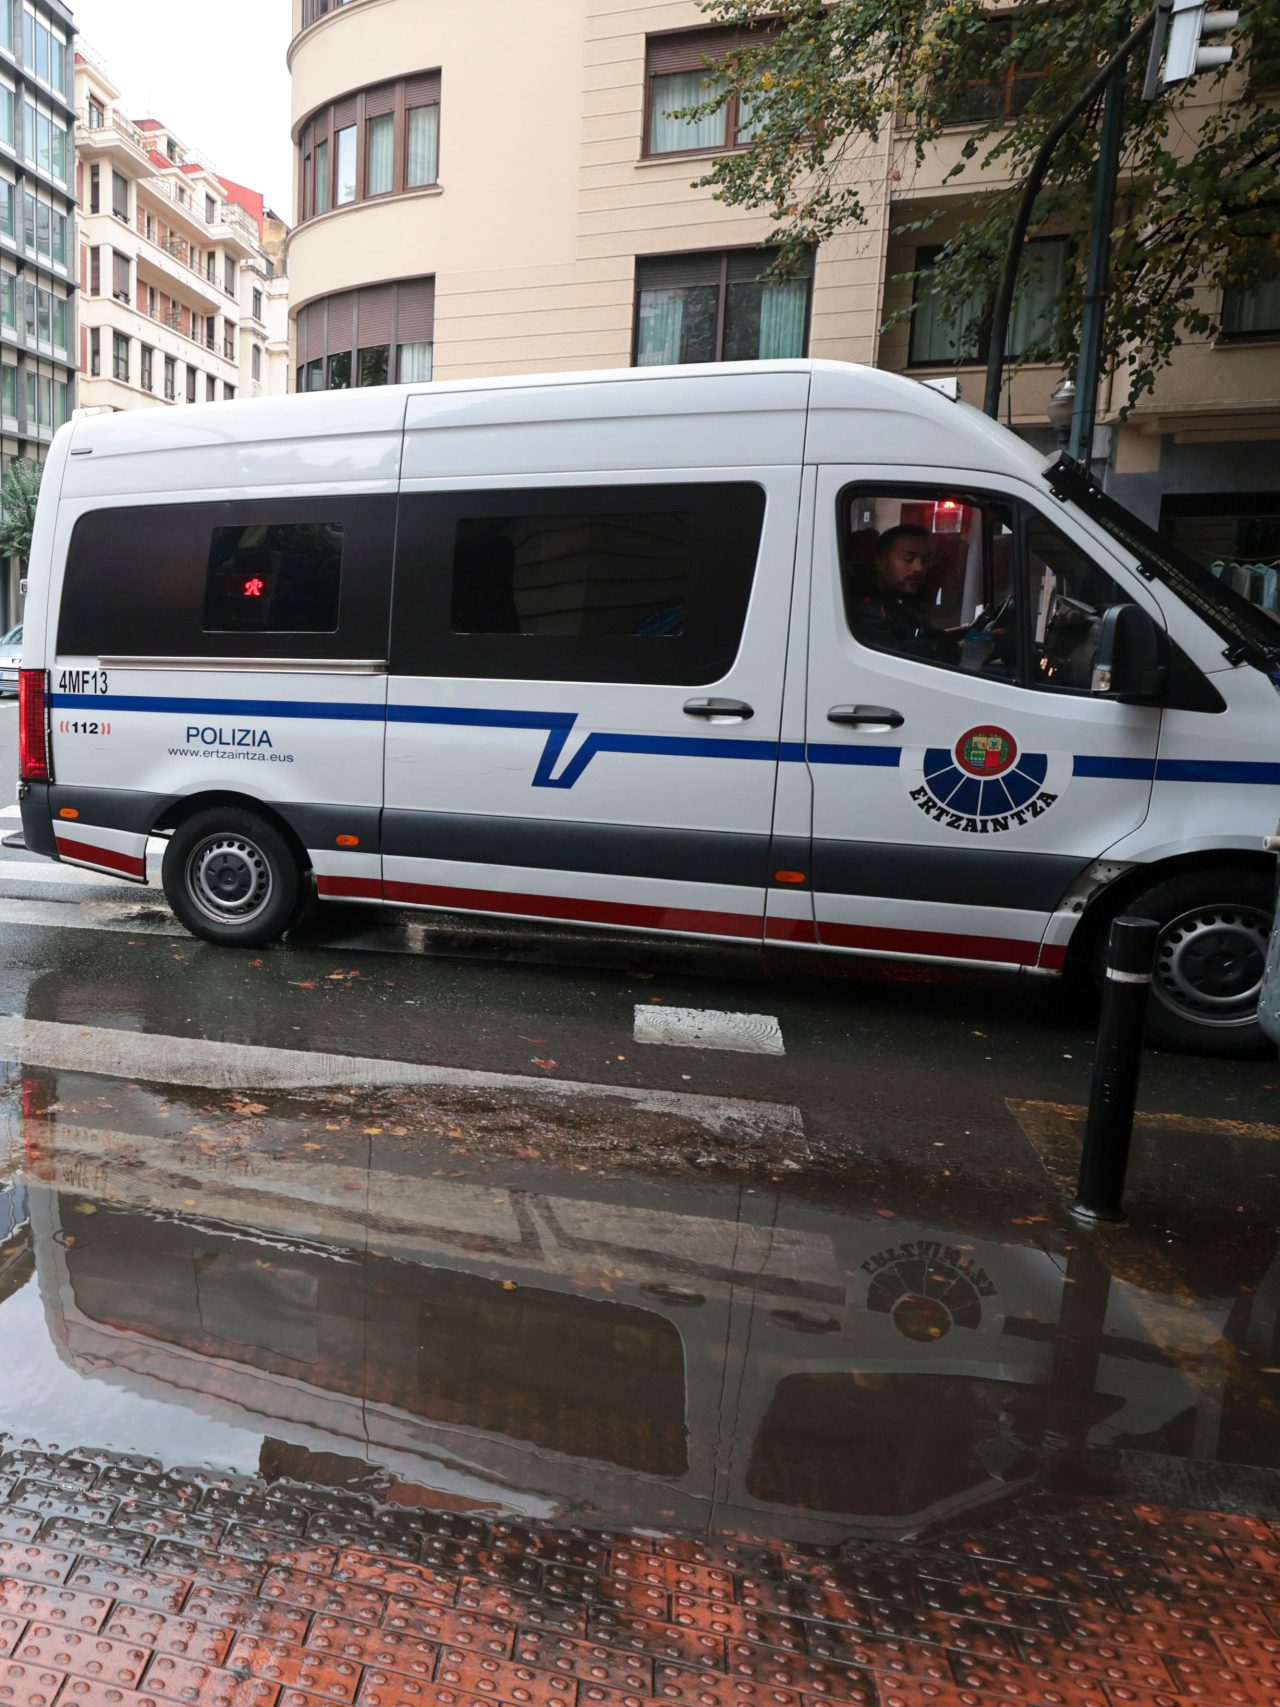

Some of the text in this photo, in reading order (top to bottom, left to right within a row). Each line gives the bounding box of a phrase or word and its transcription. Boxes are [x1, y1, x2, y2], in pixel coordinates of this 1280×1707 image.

[59, 670, 108, 694] 4MF13
[186, 726, 272, 747] POLIZIA
[168, 747, 294, 763] www.ertzaintza.eus
[909, 785, 1058, 833] ERTZAINTZA
